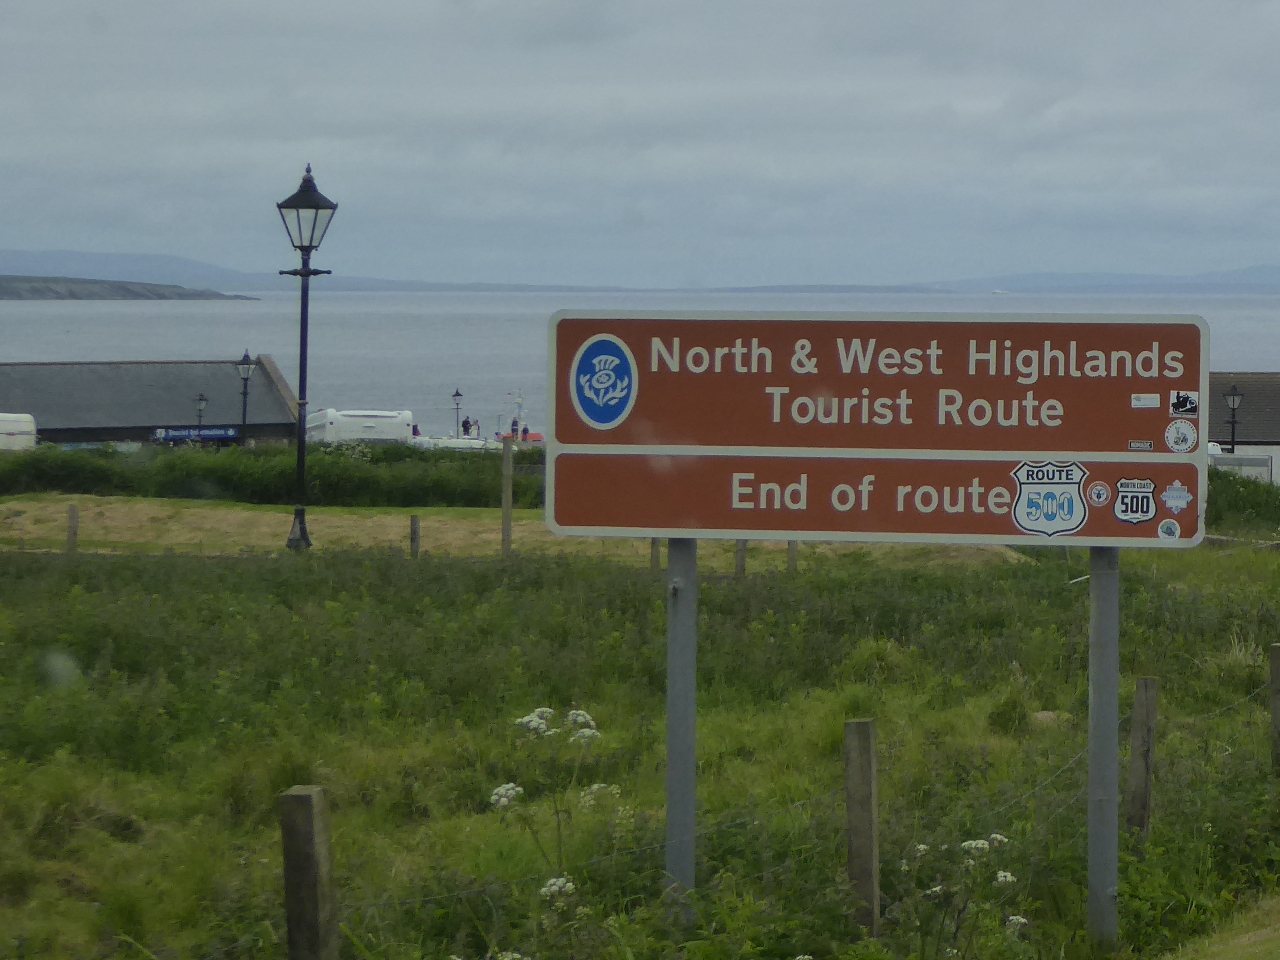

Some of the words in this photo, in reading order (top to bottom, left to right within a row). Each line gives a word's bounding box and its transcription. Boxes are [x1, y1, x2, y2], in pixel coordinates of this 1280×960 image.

[651, 337, 772, 374] North
[790, 338, 819, 374] &
[837, 338, 943, 375] West
[968, 339, 1184, 385] Highlands
[765, 386, 913, 424] Tourist
[938, 389, 1064, 427] Route
[1026, 469, 1074, 481] ROUTE
[732, 472, 808, 510] End
[831, 474, 876, 512] of
[897, 476, 1011, 515] route
[1026, 491, 1074, 521] 500
[1121, 495, 1150, 514] 500
